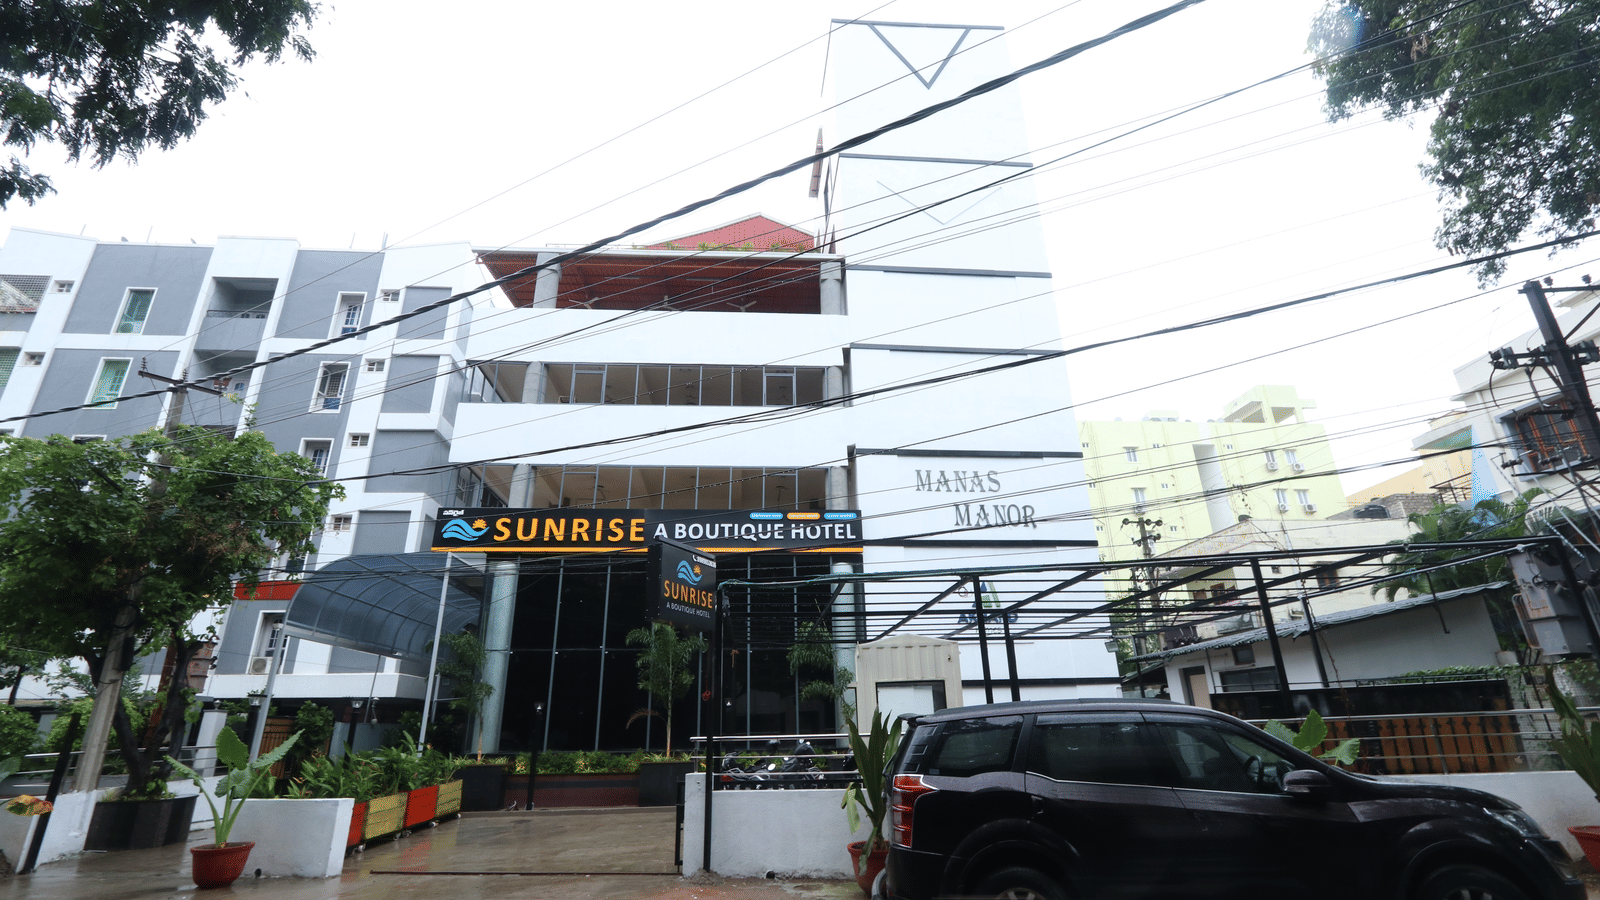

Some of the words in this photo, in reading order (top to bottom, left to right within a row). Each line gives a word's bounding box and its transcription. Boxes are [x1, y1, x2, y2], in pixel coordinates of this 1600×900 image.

[915, 469, 1001, 493] MANAS
[954, 504, 1037, 529] MANOR
[493, 517, 646, 542] SUNRISE
[653, 523, 669, 538] A
[674, 523, 785, 542] BOUTIQUE
[791, 523, 856, 540] HOTEL
[663, 580, 713, 609] SUNRISE
[666, 601, 671, 609] A
[671, 603, 696, 615] BOUTIQUE
[696, 609, 711, 618] HOTEL
